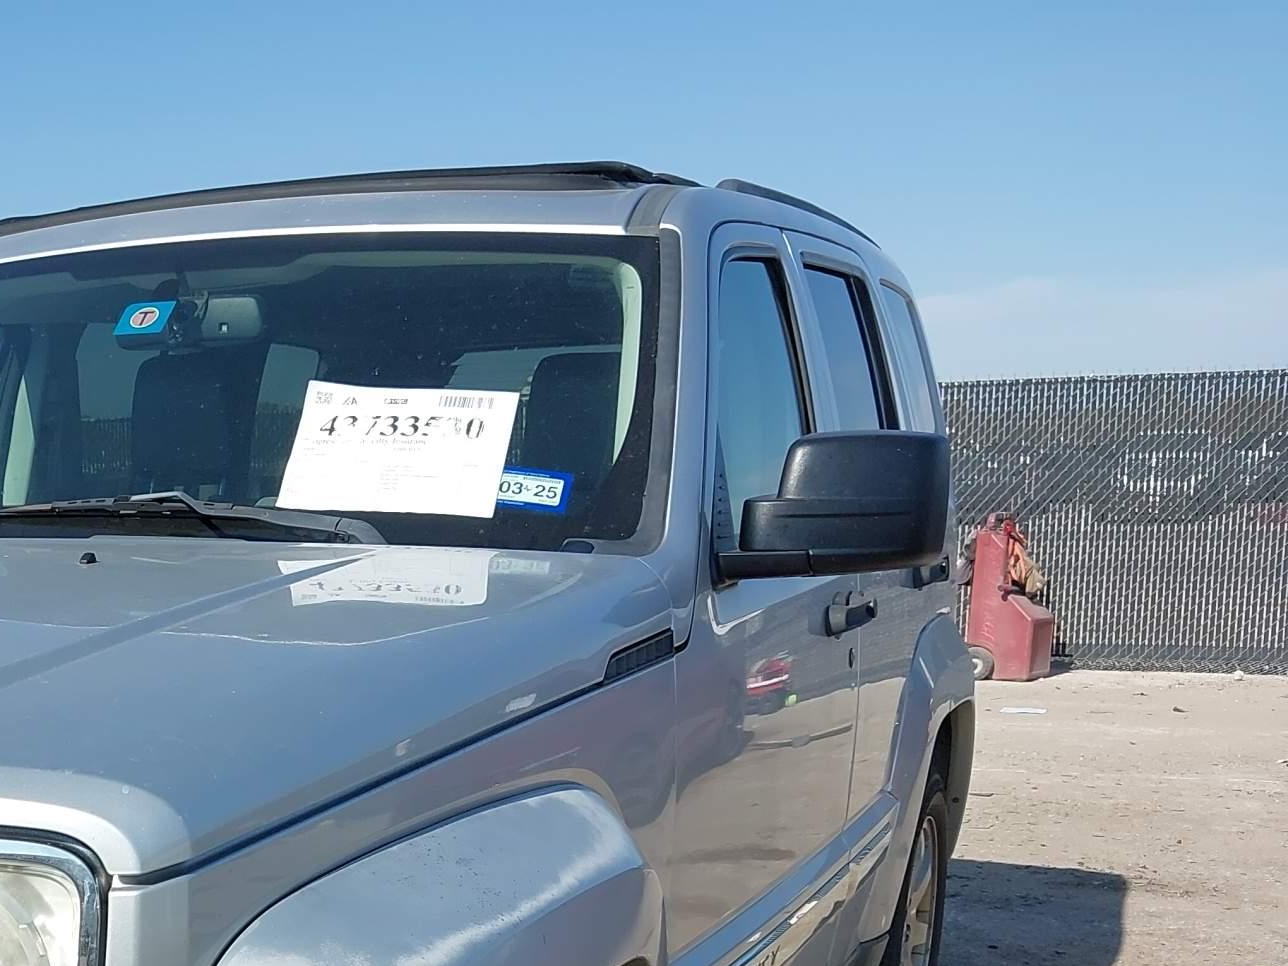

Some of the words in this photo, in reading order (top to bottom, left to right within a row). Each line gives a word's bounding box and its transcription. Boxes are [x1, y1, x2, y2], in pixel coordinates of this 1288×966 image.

[138, 311, 156, 326] T
[498, 480, 523, 494] 03
[533, 484, 558, 499] 25
